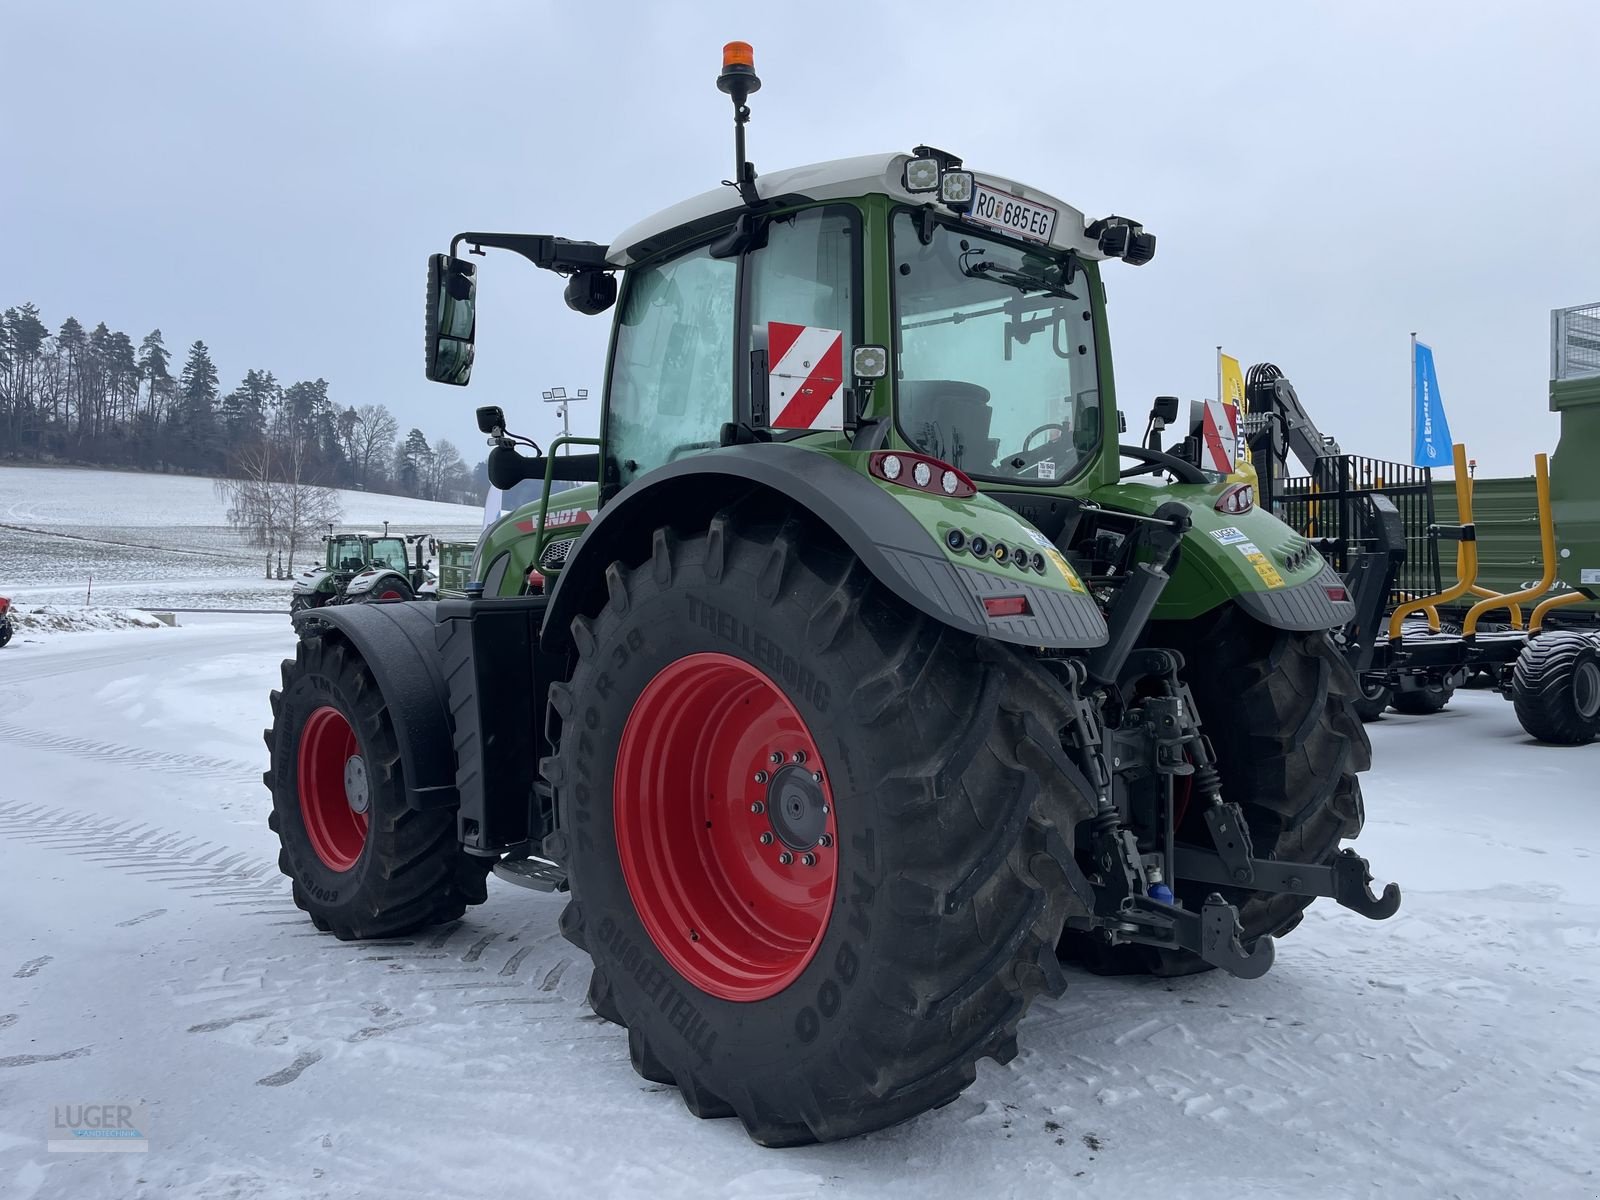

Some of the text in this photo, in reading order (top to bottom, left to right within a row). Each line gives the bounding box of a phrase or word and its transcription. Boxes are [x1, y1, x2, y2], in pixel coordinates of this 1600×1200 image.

[976, 192, 1048, 235] RO 685 EG
[531, 507, 582, 529] FENDT
[612, 627, 644, 670] 38
